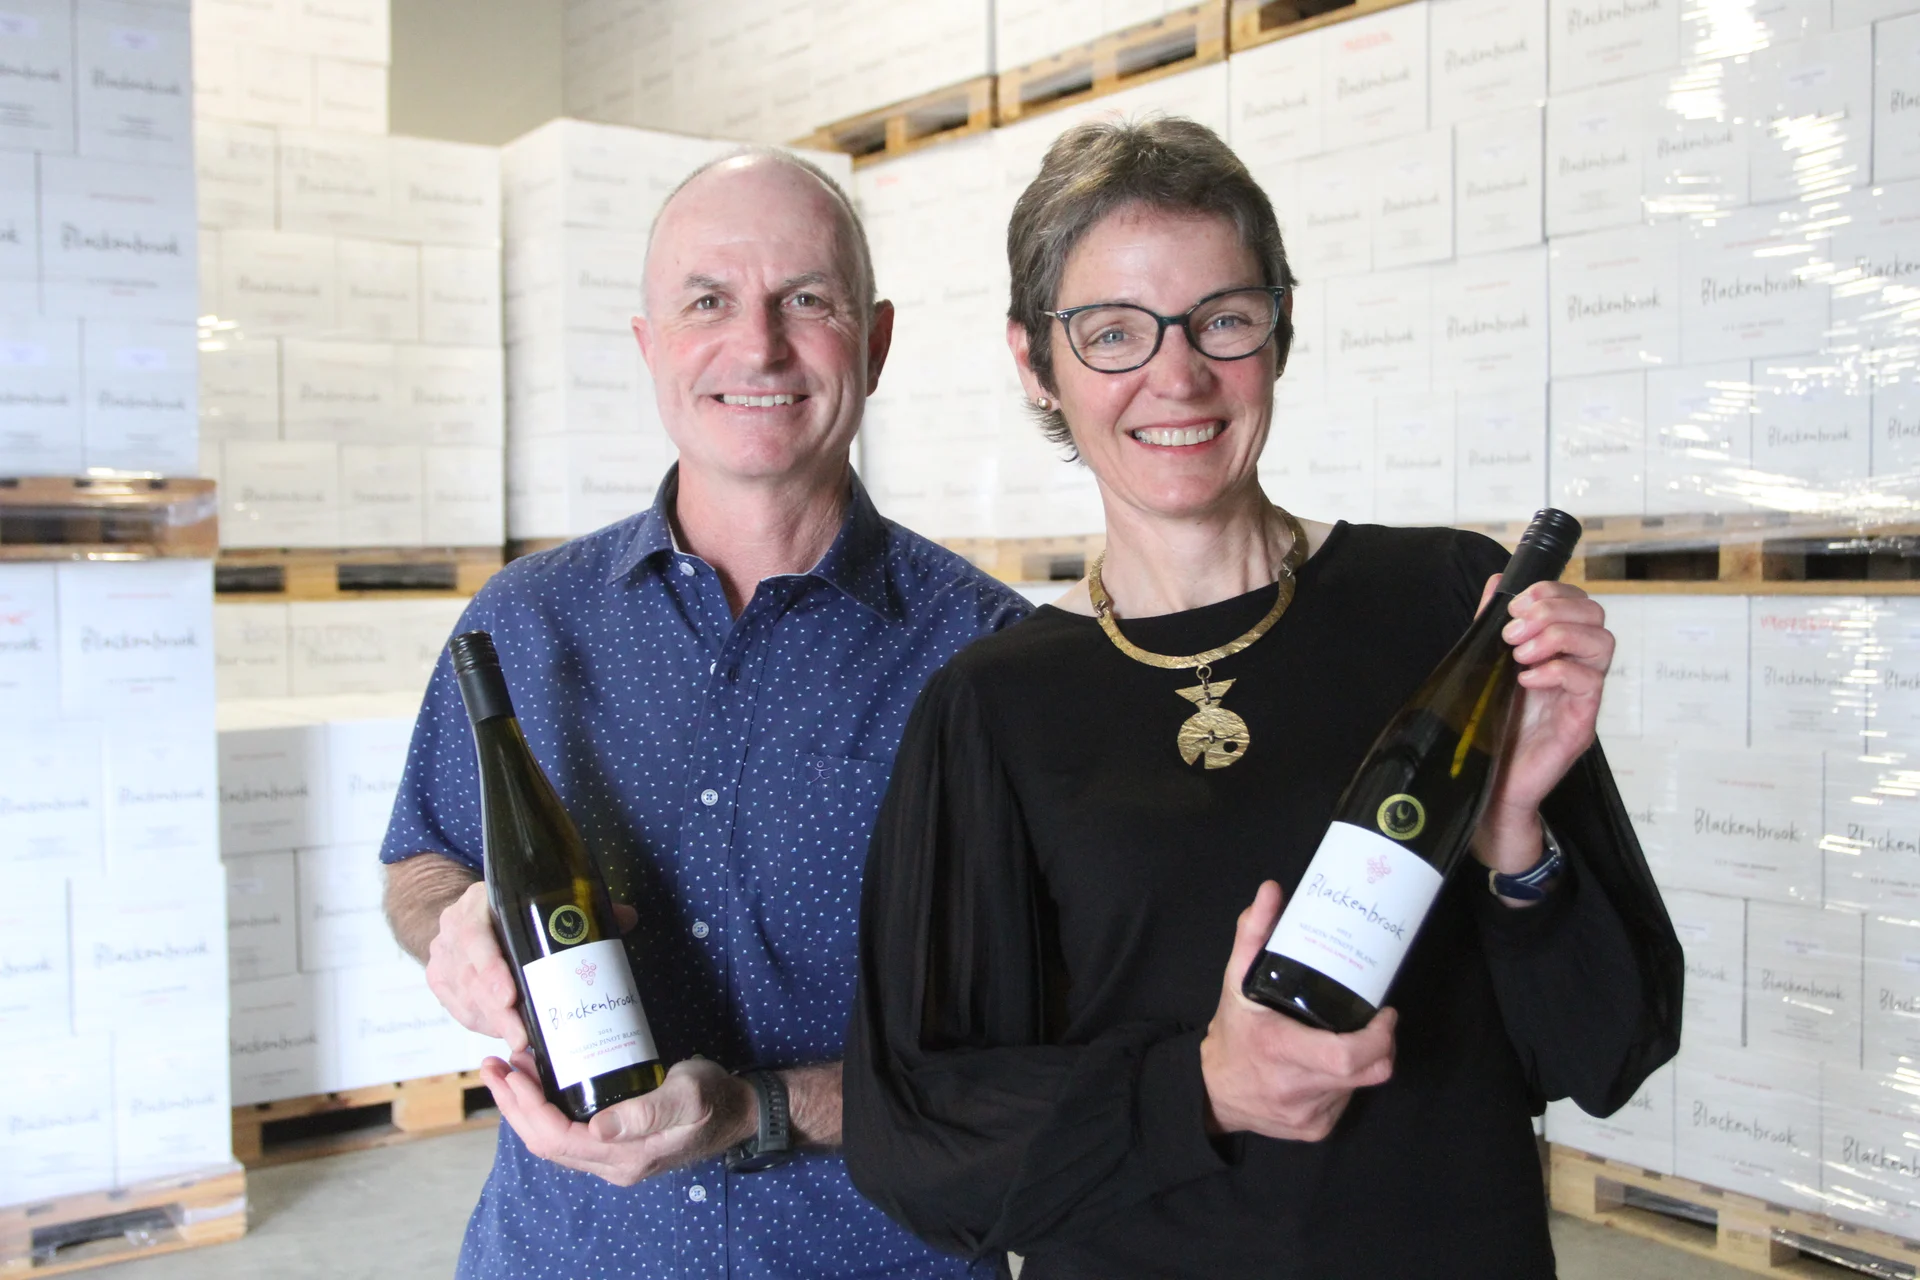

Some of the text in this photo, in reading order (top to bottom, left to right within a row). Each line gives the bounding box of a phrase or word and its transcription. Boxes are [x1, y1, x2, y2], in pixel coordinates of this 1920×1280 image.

[1694, 808, 1801, 844] Blackenbrook
[1306, 873, 1405, 941] Blackenbrook
[549, 990, 637, 1030] Blackenbrook
[599, 1034, 621, 1046] PINOT
[622, 1029, 641, 1039] BLANC
[1692, 1100, 1799, 1148] Blackenbrook
